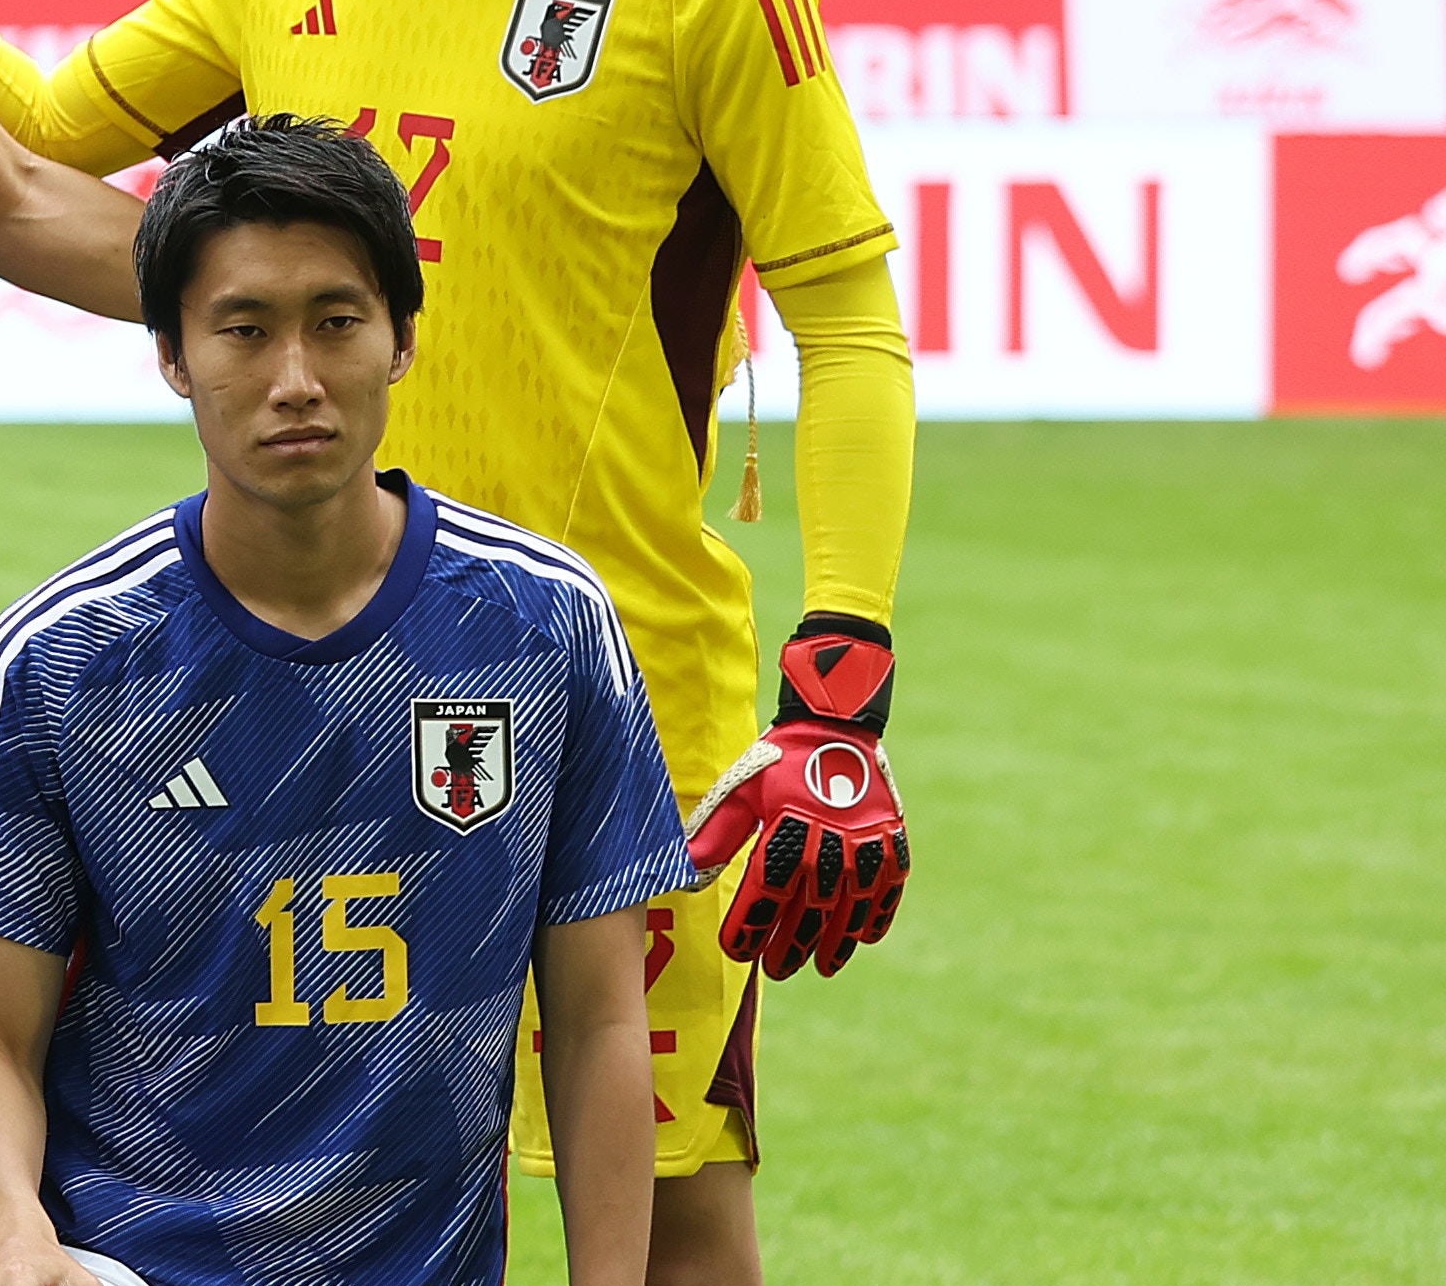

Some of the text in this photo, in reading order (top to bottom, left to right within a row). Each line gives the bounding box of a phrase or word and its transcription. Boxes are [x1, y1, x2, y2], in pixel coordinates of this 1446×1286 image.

[522, 59, 562, 83] JFA
[344, 107, 455, 262] 2
[436, 705, 487, 716] JAPAN
[441, 787, 484, 809] JFA
[254, 872, 409, 1027] 15
